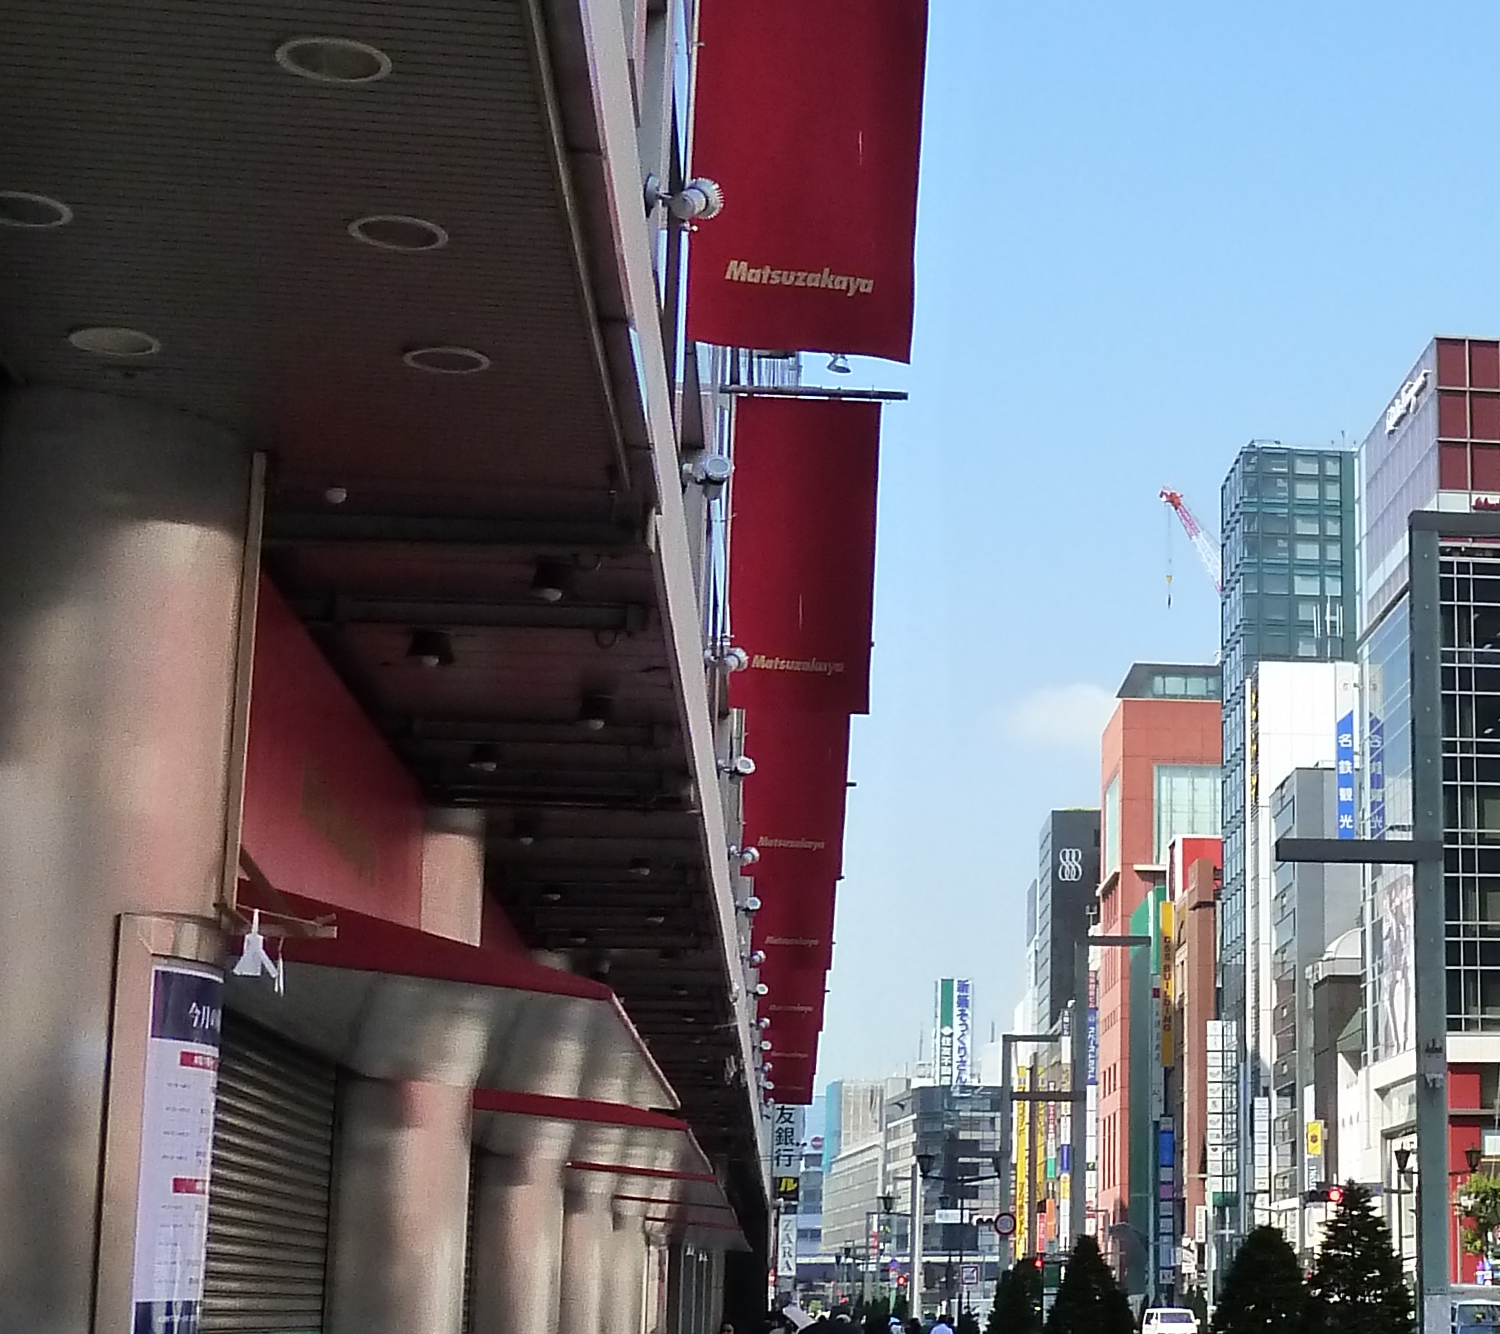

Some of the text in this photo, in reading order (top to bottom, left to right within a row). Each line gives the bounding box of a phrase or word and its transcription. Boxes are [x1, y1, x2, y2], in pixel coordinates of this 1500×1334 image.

[725, 260, 874, 297] Matsuzakaya
[751, 654, 844, 676] Matsuzakaya
[1338, 733, 1354, 829] 名鉄観光
[1163, 964, 1172, 1032] BUILDING
[956, 979, 970, 1085] 新築そっくりさん
[774, 1105, 797, 1168] 友銀行
[781, 1219, 793, 1272] ZARA
